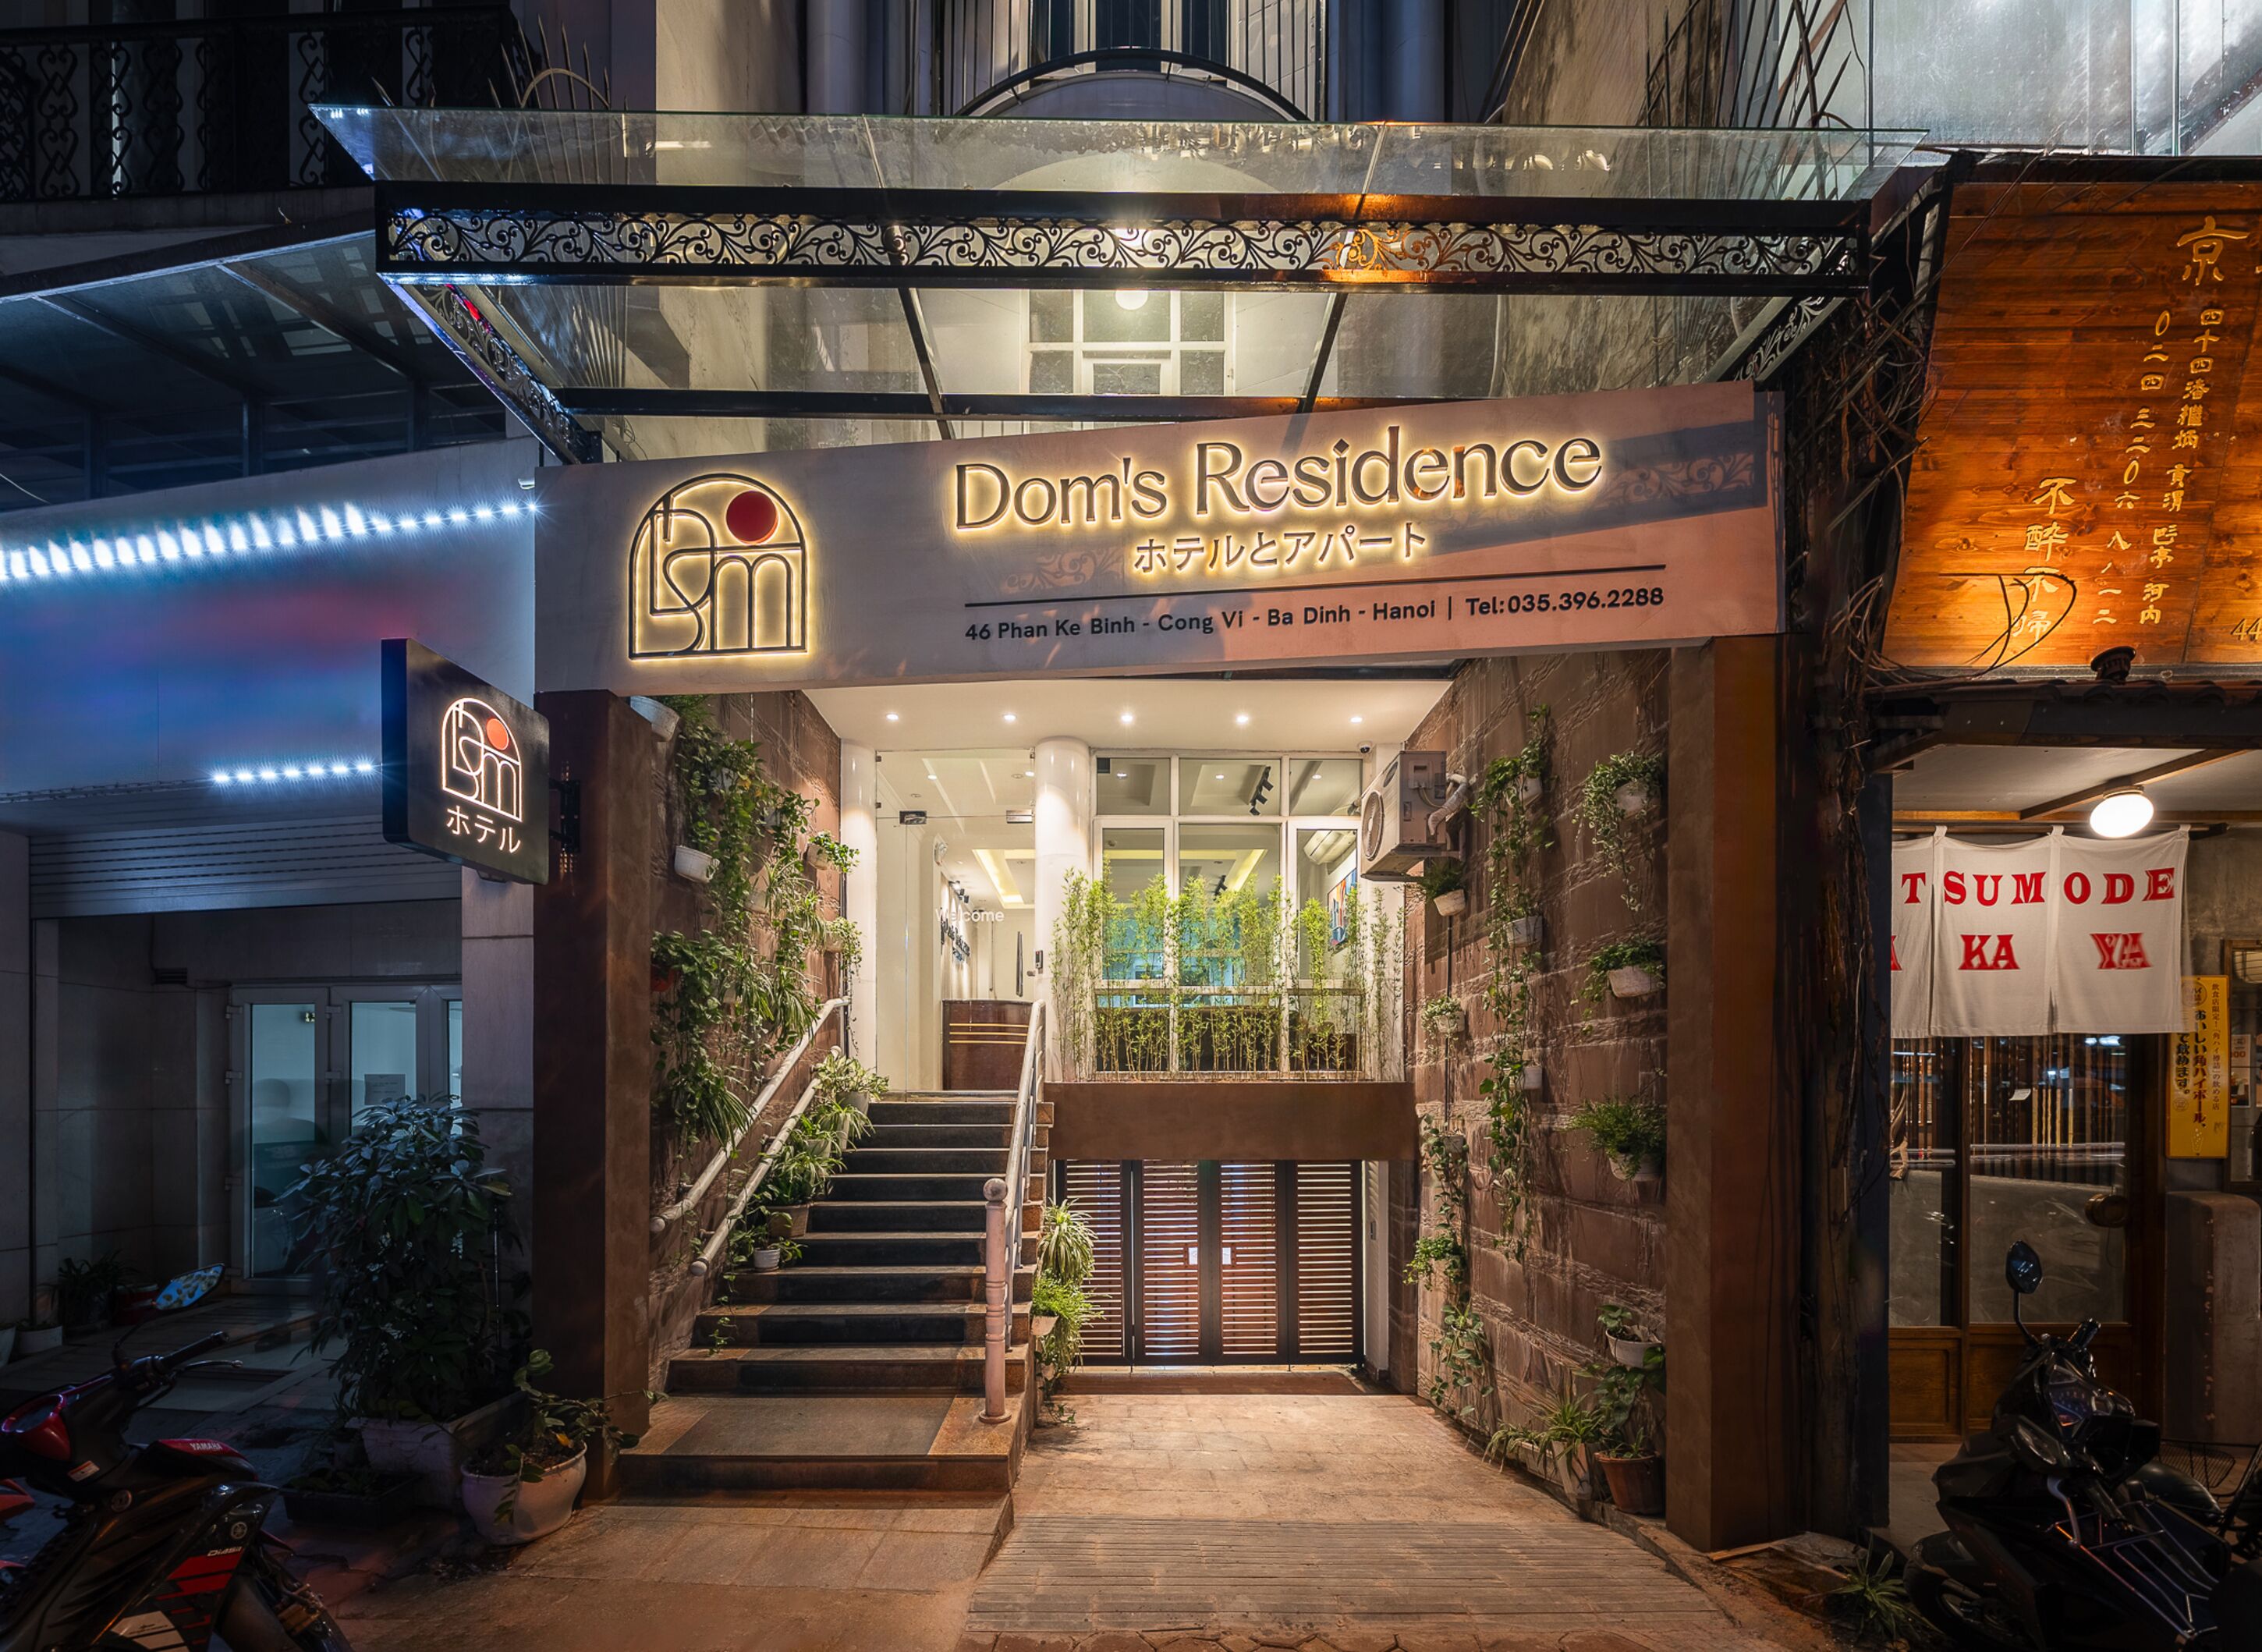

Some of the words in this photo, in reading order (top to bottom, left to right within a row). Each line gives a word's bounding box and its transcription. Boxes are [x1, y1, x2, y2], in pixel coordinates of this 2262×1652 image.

[2177, 216, 2250, 285] 京
[956, 457, 1167, 529] Dom's
[1196, 426, 1603, 515] Residence
[1134, 522, 1425, 573] ホテルとアパート
[965, 623, 991, 640] 46
[998, 622, 1048, 639] Phan
[1055, 619, 1080, 636] Ke
[1090, 617, 1134, 634] Binh
[1158, 614, 1214, 634] Cong
[1222, 610, 1243, 628] Vi
[1268, 608, 1292, 626] Ba
[1304, 605, 1350, 624] Dinh
[1373, 600, 1435, 621] Hanoi
[2230, 618, 2262, 640] 44
[446, 805, 521, 853] ホテル
[935, 908, 1005, 922] Welcome
[190, 1442, 223, 1451] YAMAHA
